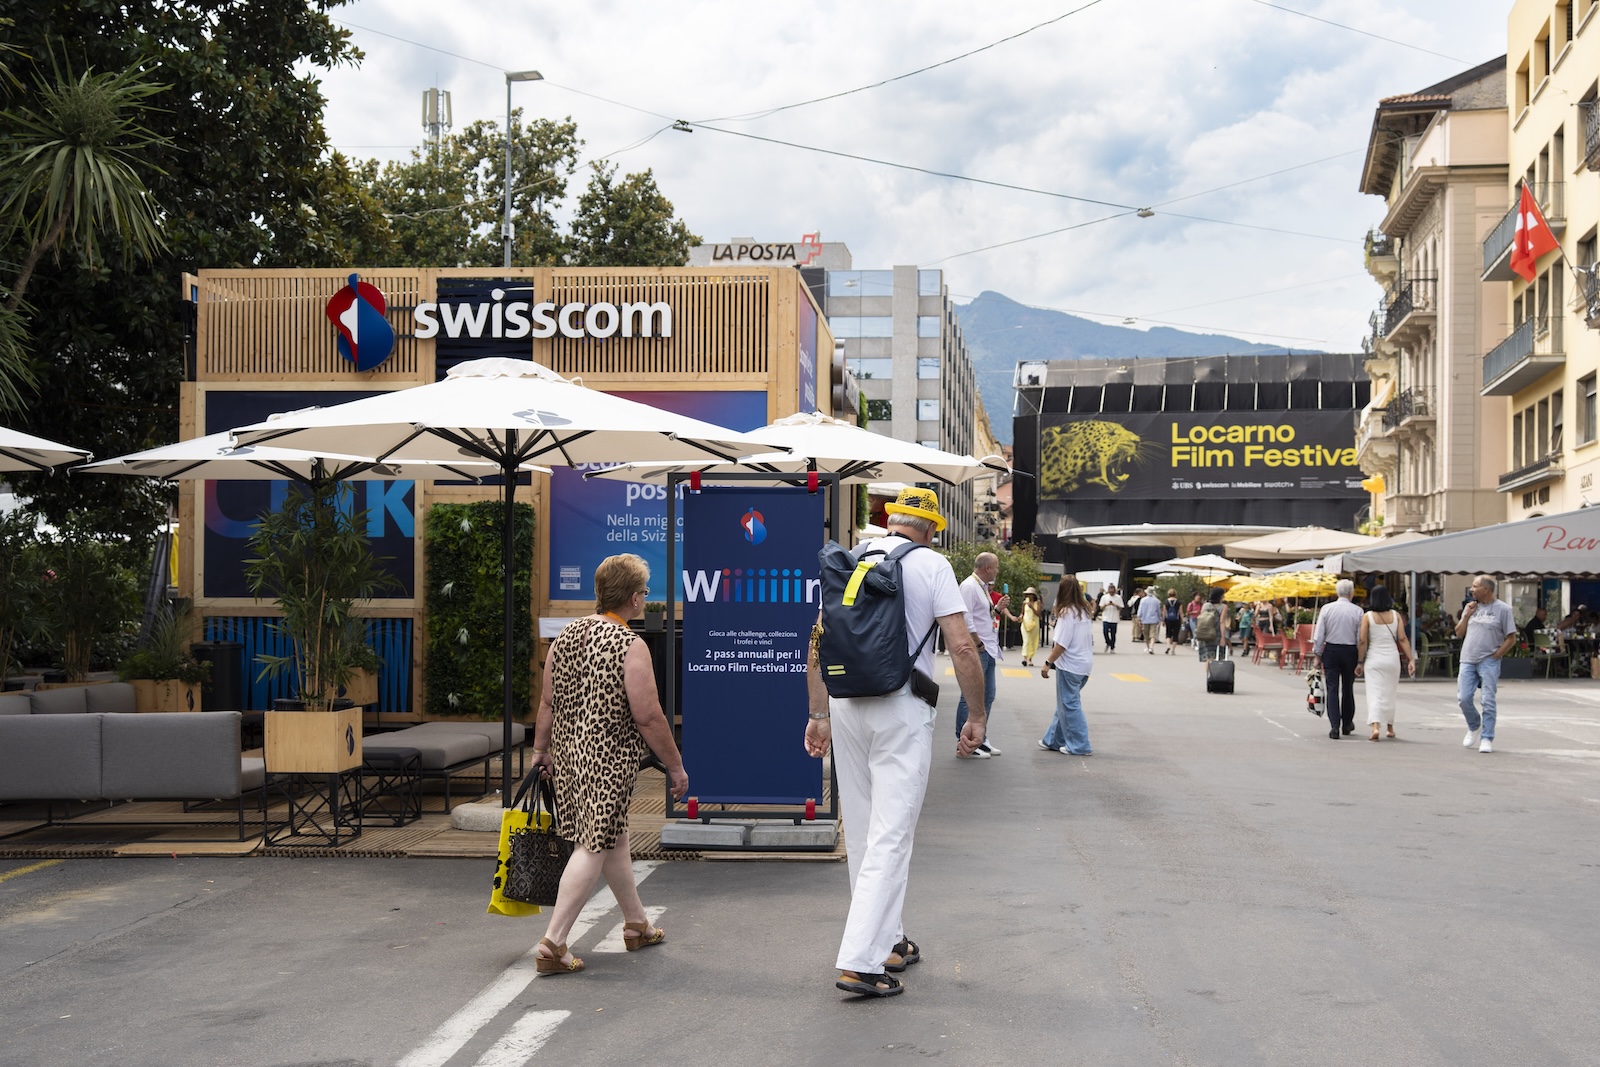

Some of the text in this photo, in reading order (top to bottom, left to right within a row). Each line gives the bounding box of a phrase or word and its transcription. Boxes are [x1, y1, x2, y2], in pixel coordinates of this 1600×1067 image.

[712, 244, 796, 260] LA POSTA
[414, 288, 672, 339] swisscom
[1172, 422, 1296, 444] Locarno
[1172, 444, 1358, 467] Film Festiva
[606, 513, 684, 531] Nella migo
[606, 528, 638, 542] della
[738, 630, 767, 638] challenge,
[705, 649, 801, 661] 2 pass annuali per il
[688, 662, 808, 673] Locarno Film Festival 202
